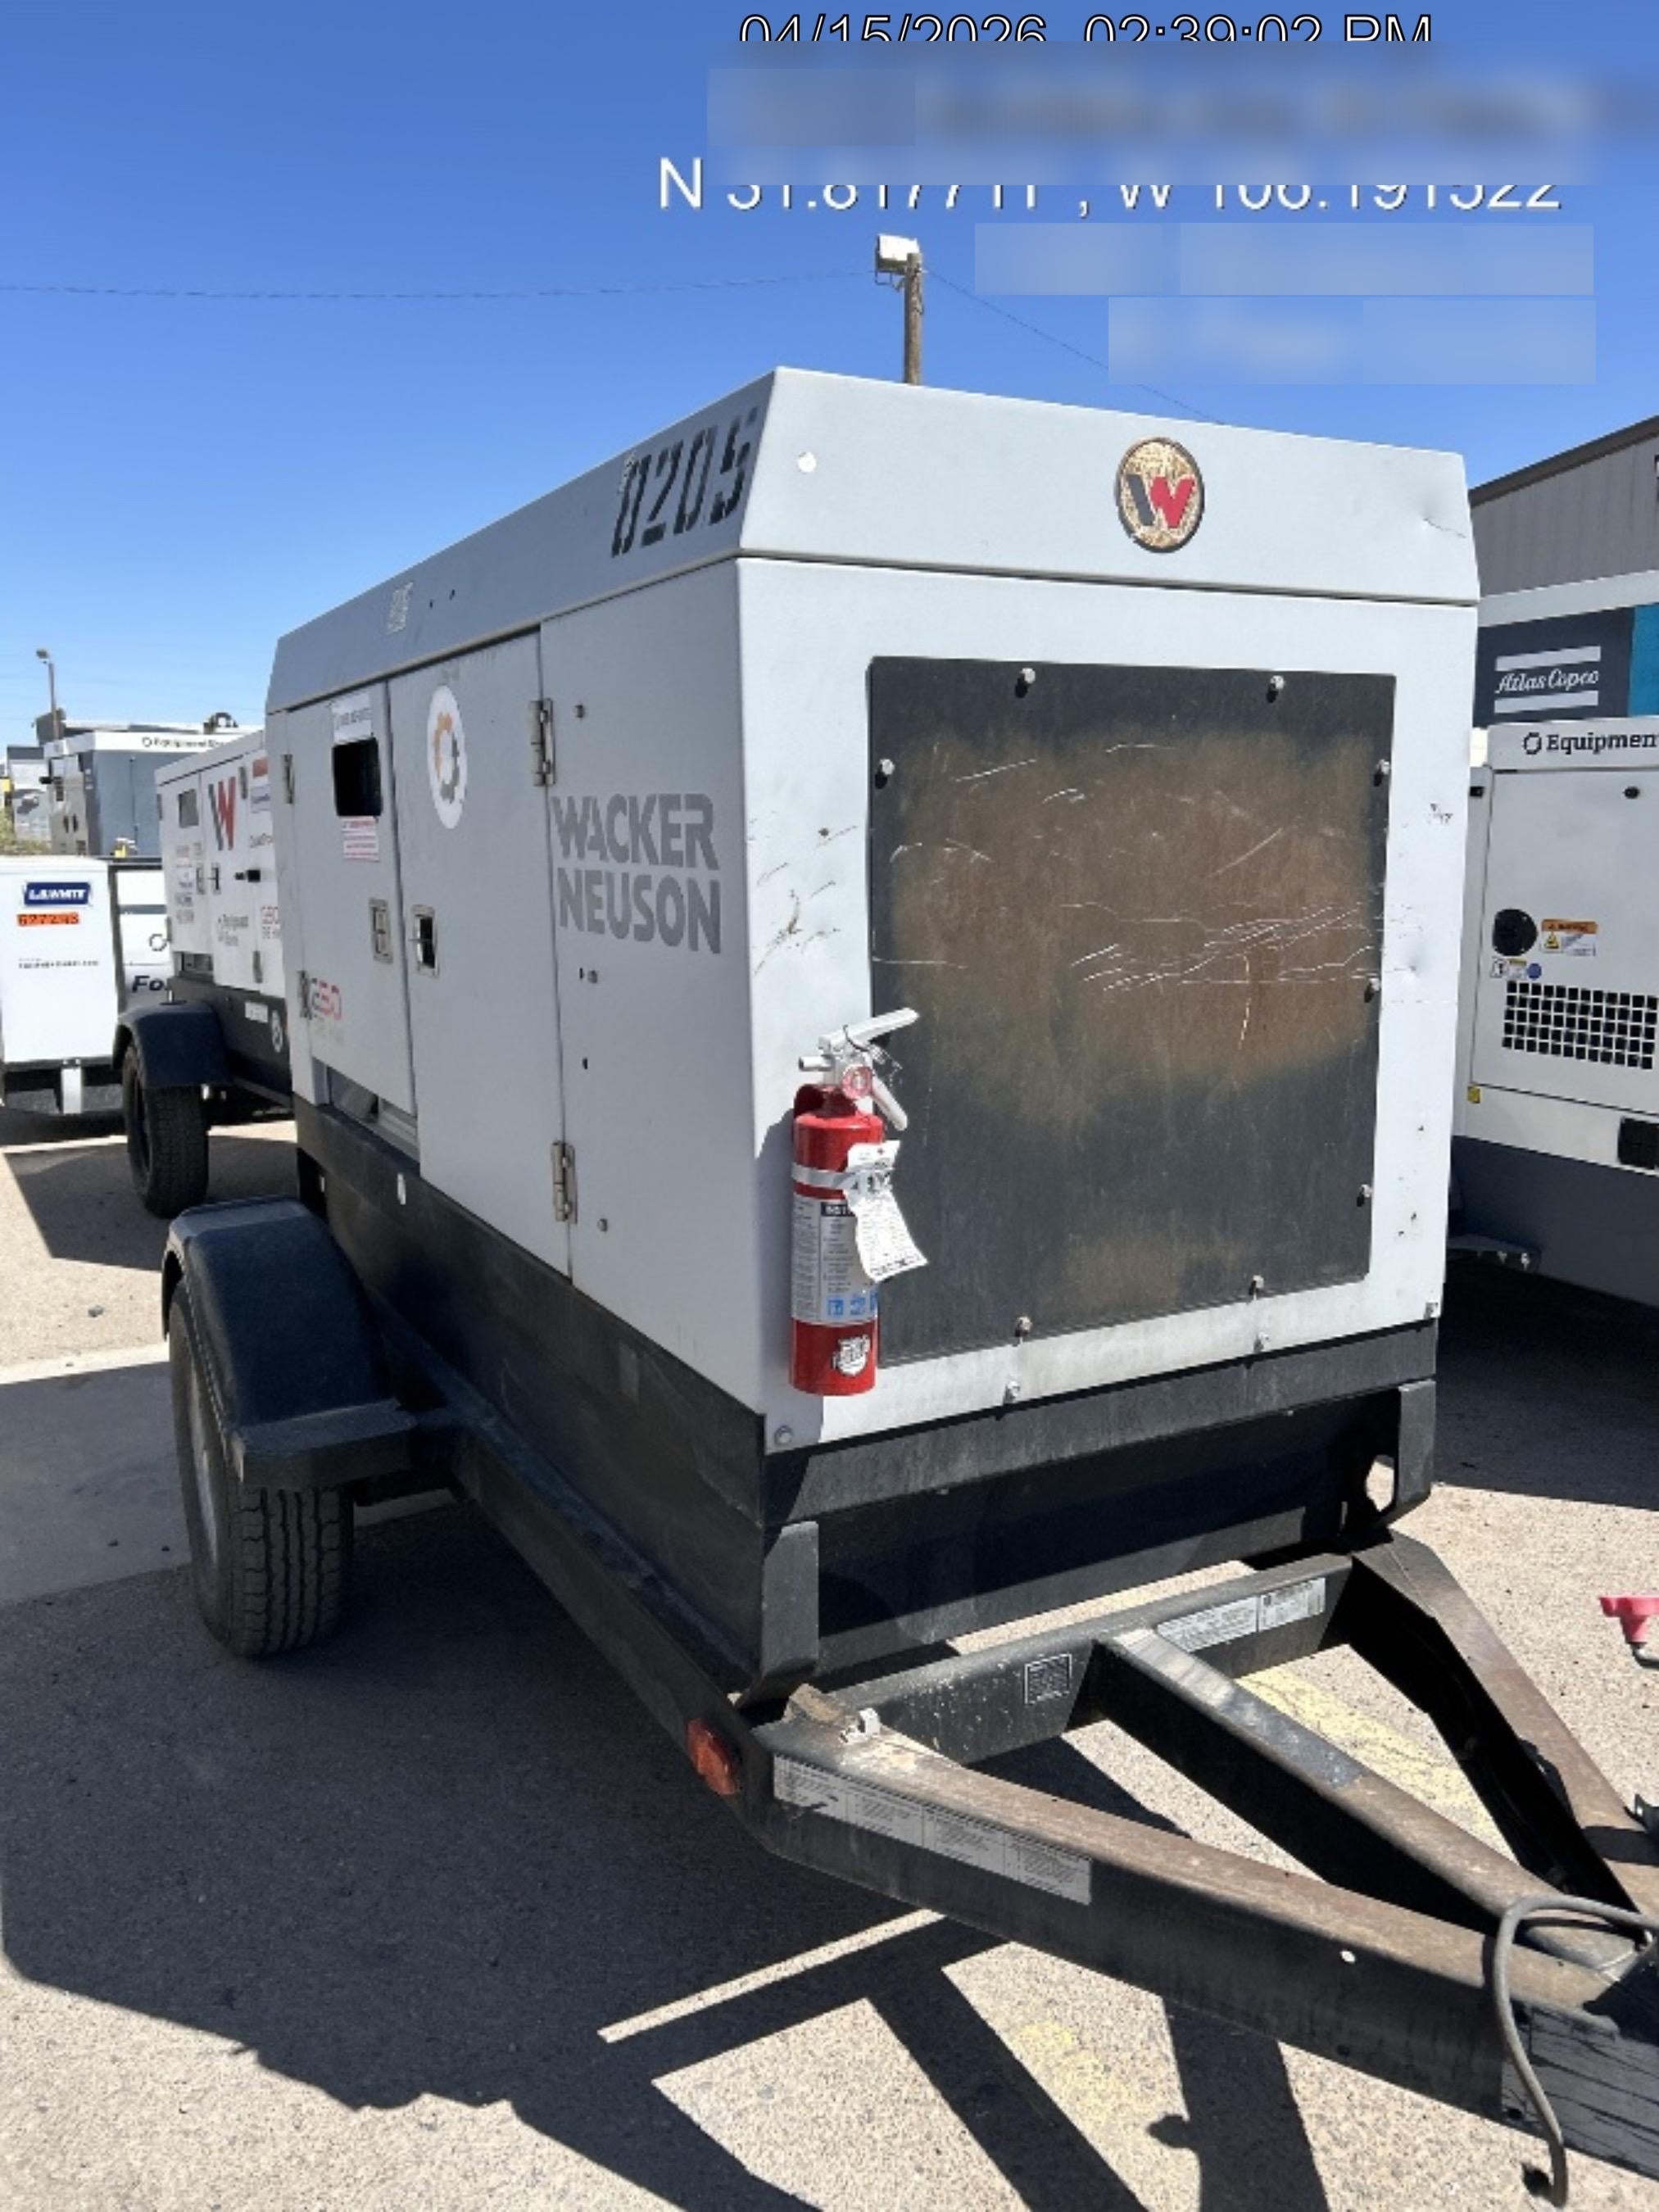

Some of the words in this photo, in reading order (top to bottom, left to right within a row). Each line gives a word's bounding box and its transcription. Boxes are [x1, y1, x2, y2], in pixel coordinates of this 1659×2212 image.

[1495, 672, 1547, 694] Atlas
[1548, 668, 1599, 691] Copco
[1547, 732, 1659, 755] Equipmen
[552, 793, 720, 871] WACKER
[557, 867, 721, 954] NEUSON
